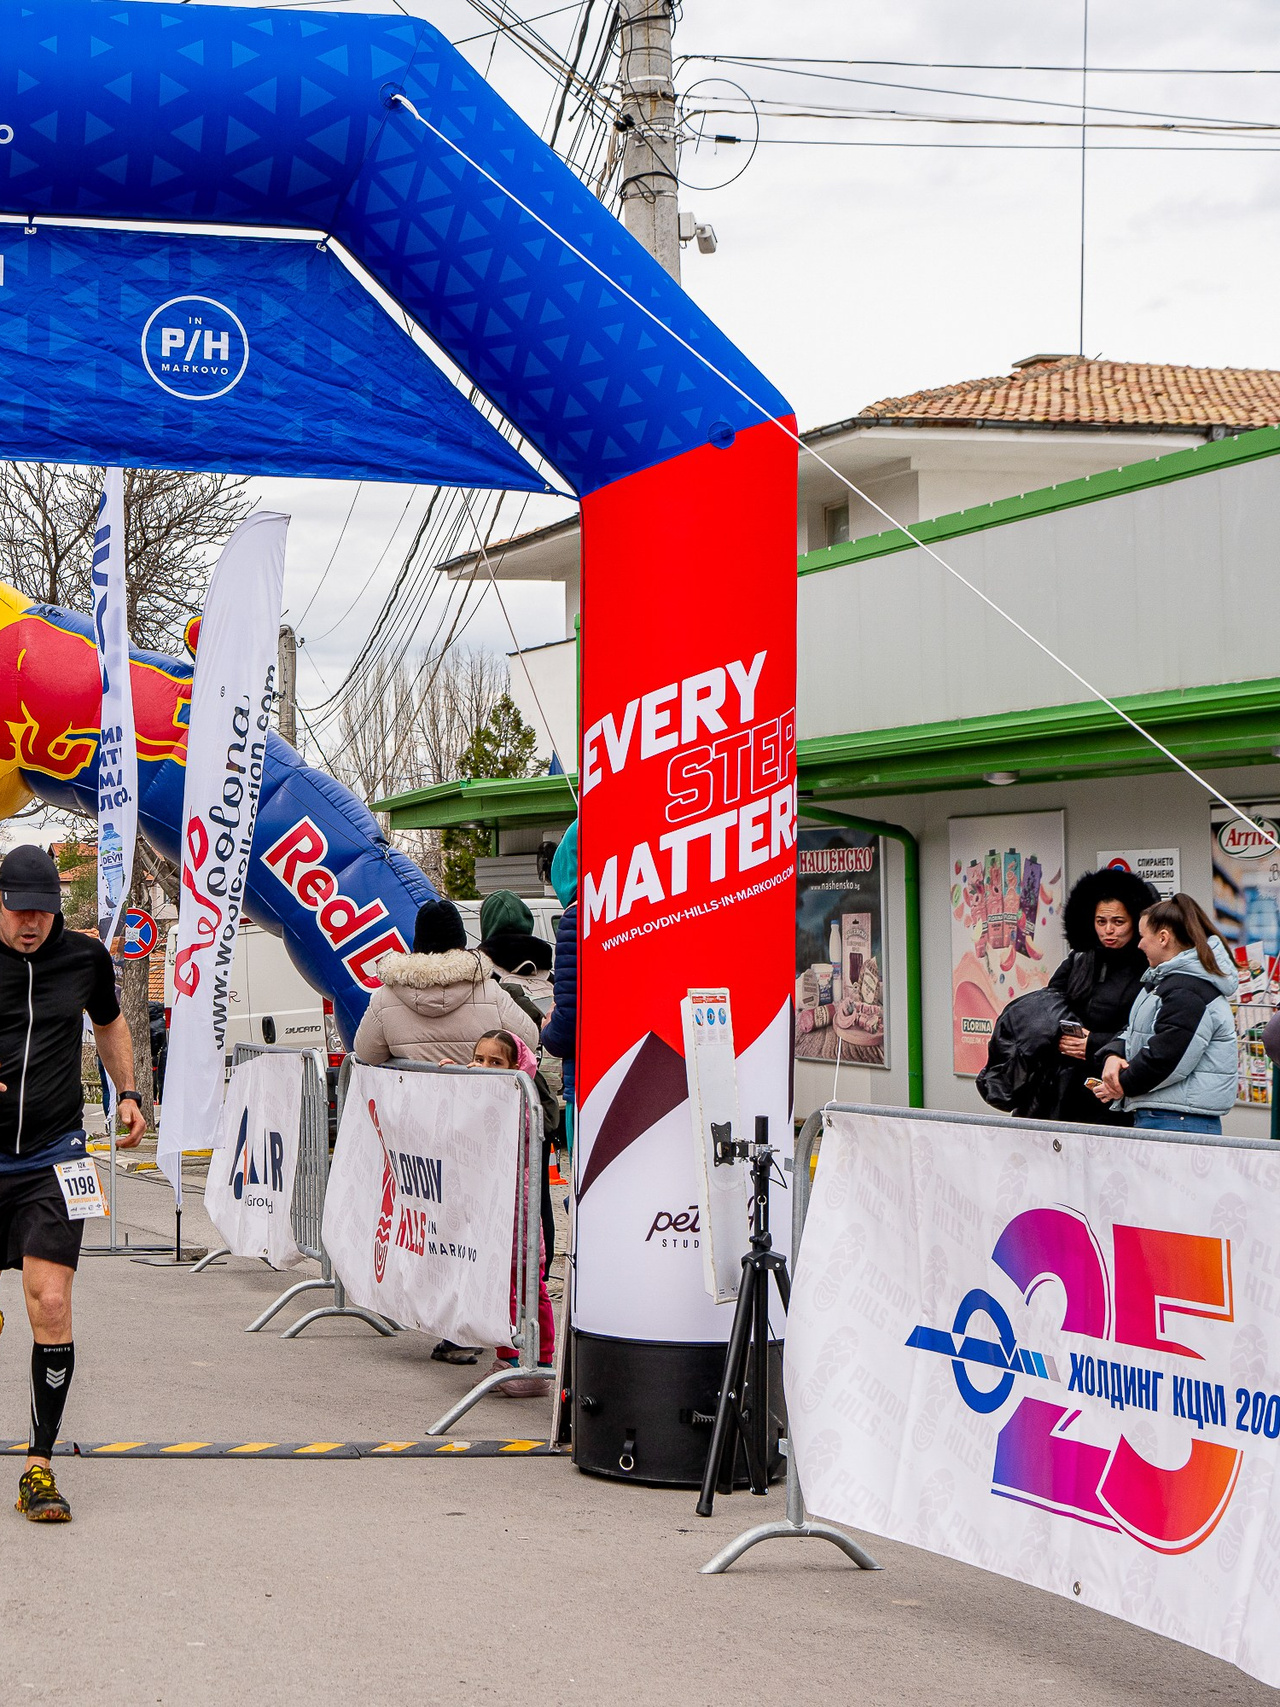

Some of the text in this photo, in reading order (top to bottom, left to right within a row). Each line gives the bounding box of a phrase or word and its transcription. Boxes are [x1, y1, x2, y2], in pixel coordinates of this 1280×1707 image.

[188, 316, 203, 326] IN
[161, 326, 231, 362] P/H
[161, 363, 230, 377] MARKOVO
[583, 650, 768, 798] EVERY
[665, 706, 797, 823] STEP
[1225, 828, 1275, 847] Arriva
[799, 846, 874, 874] НАШЕНСКО
[1137, 857, 1174, 867] СПИРАНЕТО
[262, 815, 389, 950] Red
[810, 880, 861, 891] www.nashensko.bg
[601, 864, 795, 952] WWW.PLOVDIV-HILLS-IN-MARKOVO.COM
[284, 1025, 322, 1035] DUCATO
[962, 1018, 993, 1033] FLORINA
[64, 1175, 96, 1196] 1198
[427, 1221, 438, 1235] IN
[428, 1241, 477, 1263] MARKOVO
[662, 1239, 700, 1248] STUD
[991, 1202, 1245, 1556] 25
[1068, 1353, 1163, 1412] ХОЛДИНГ
[1172, 1374, 1227, 1430] КЦМ
